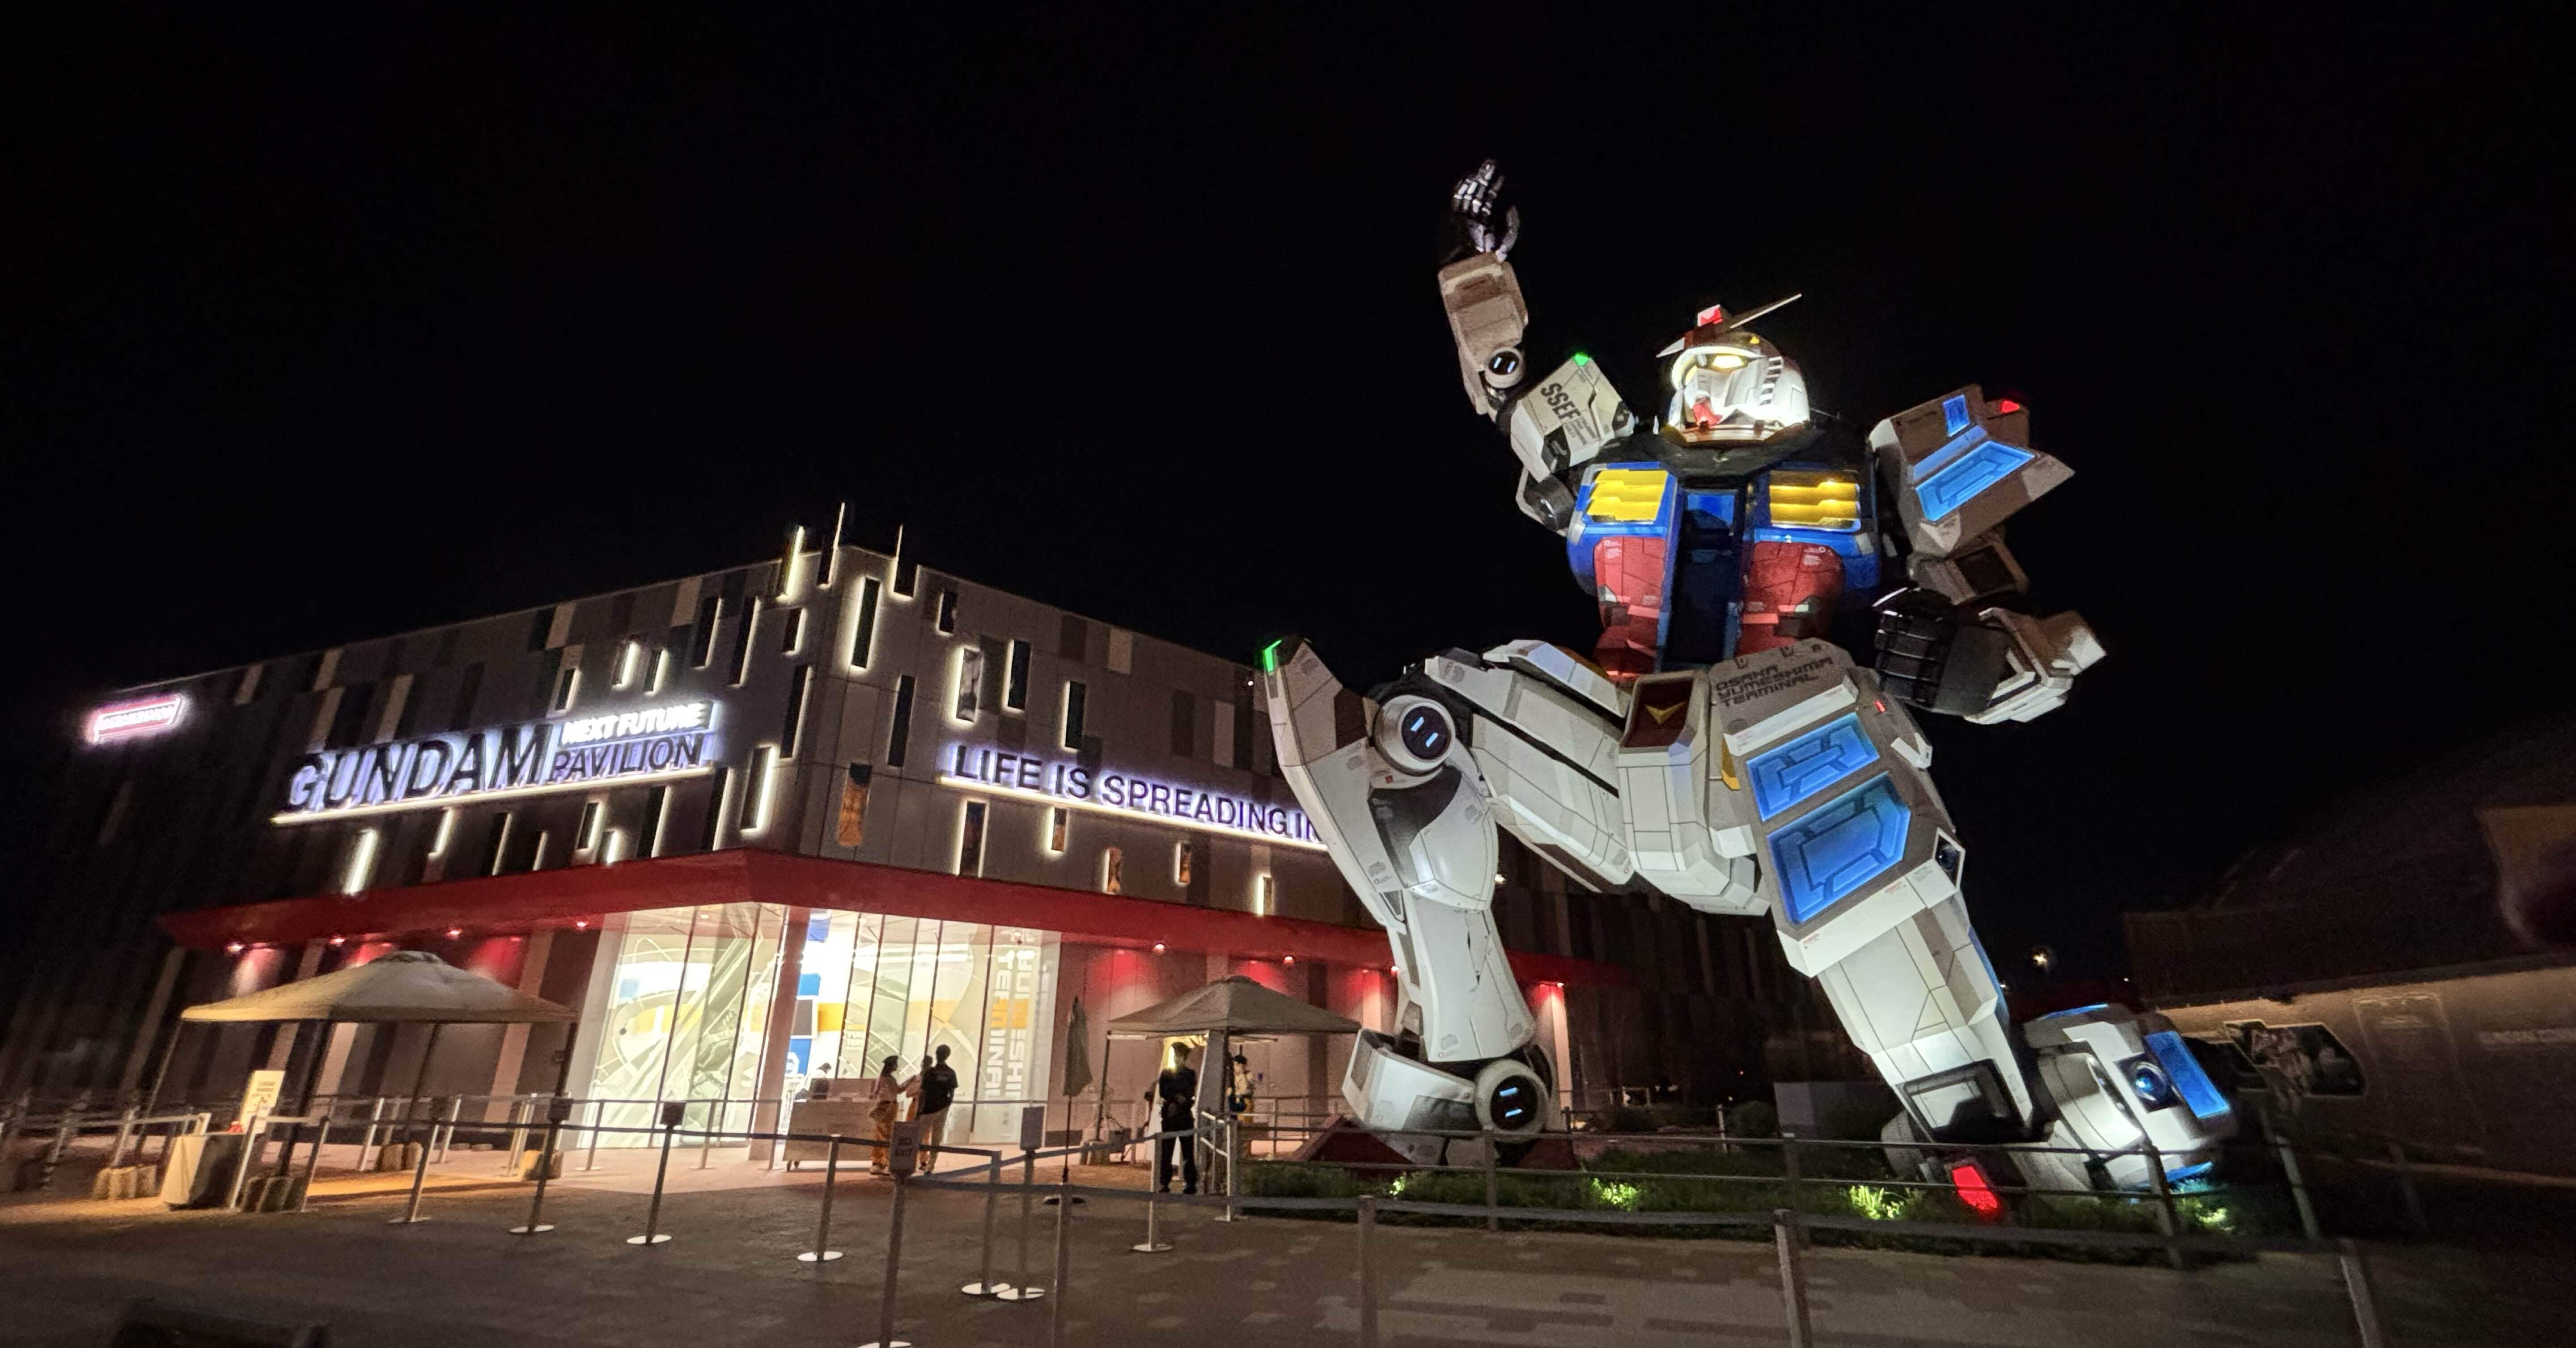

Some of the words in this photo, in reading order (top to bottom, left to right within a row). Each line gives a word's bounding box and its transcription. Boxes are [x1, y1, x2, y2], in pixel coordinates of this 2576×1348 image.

[1541, 383, 1581, 419] SSEF
[1716, 664, 1778, 691] OSAKA
[1718, 656, 1834, 700] YUMESHIMA
[1720, 673, 1820, 707] TERMINAL
[561, 715, 619, 745] NEXT
[617, 702, 711, 738] FUTURE
[284, 723, 550, 813] GUNDAM
[549, 731, 705, 782] PAVILION
[955, 745, 1043, 790] LIFE
[1055, 764, 1090, 799] IS
[1102, 774, 1288, 835] SPREADING
